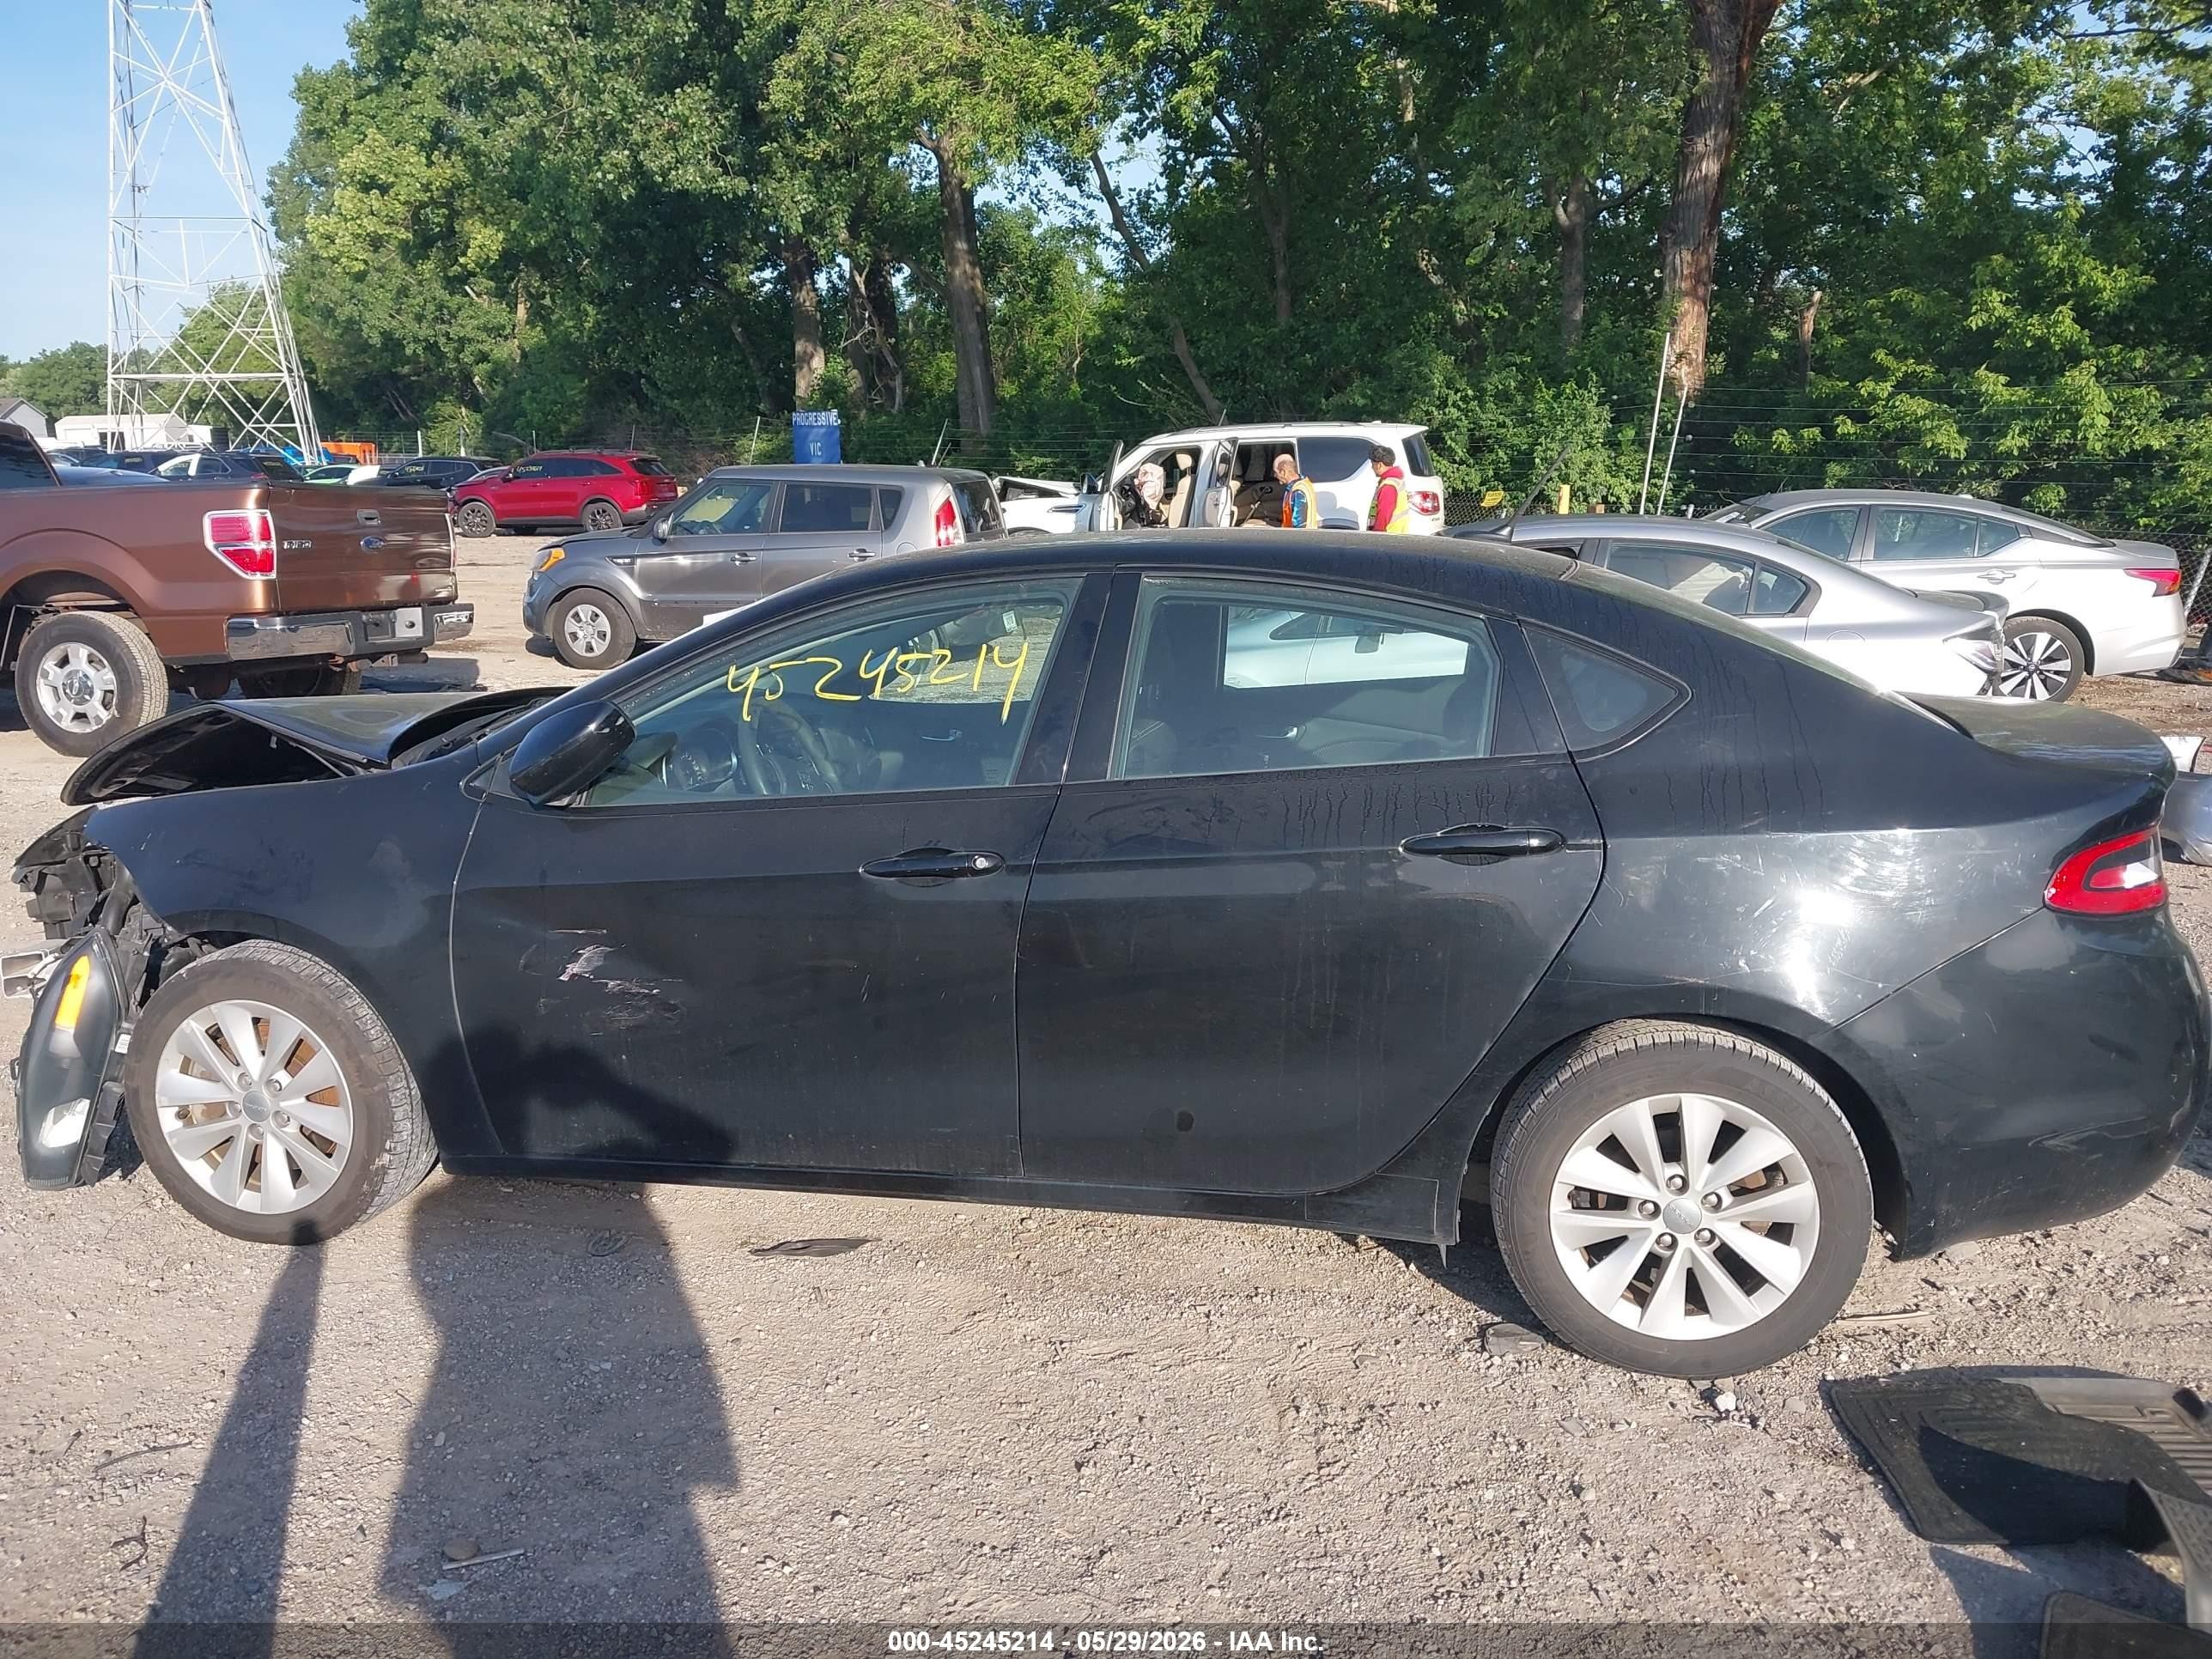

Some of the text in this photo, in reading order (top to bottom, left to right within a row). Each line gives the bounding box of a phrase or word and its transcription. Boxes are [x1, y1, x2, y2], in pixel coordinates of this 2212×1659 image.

[793, 411, 838, 426] PROGRESSIVE
[810, 441, 822, 456] VIC
[727, 642, 1029, 726] 45245214
